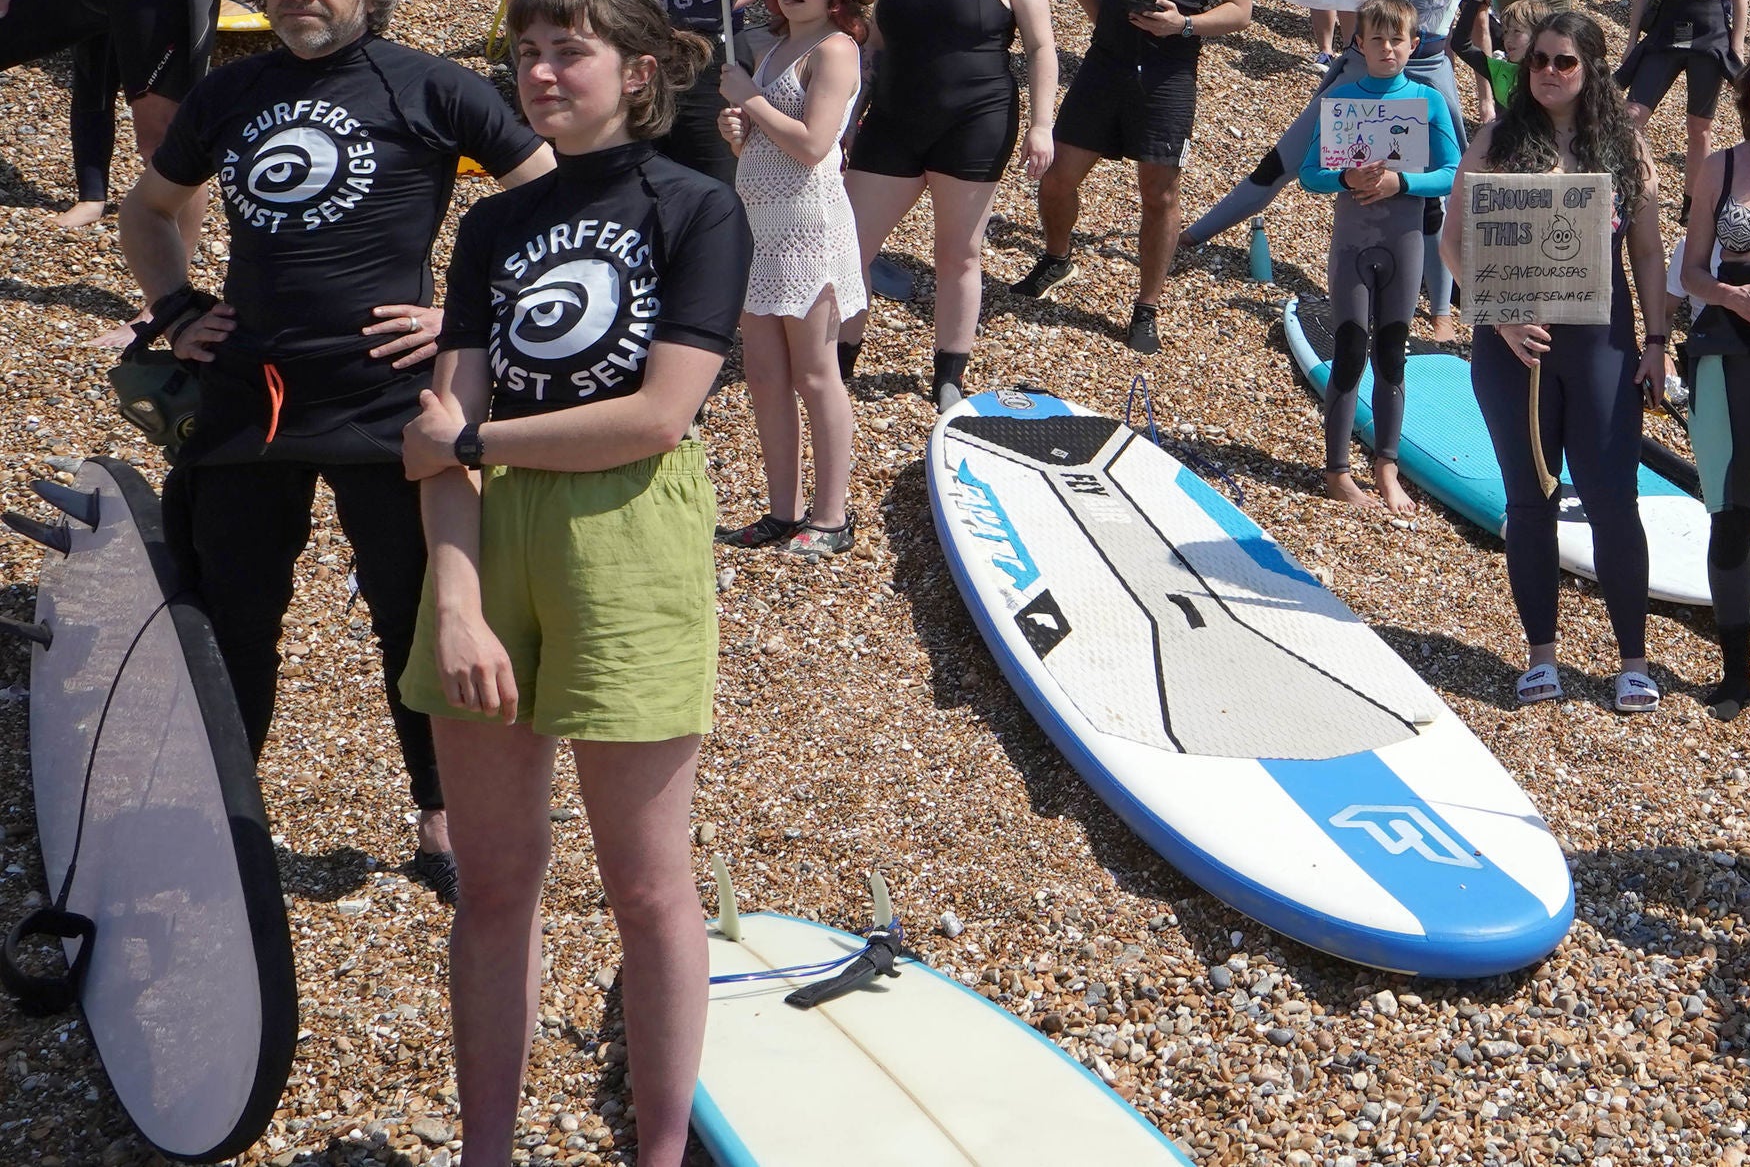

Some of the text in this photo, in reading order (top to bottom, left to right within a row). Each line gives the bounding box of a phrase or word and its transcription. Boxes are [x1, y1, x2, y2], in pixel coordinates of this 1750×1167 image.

[242, 99, 361, 143] SURFERS
[1333, 103, 1386, 118] SAVE
[1335, 133, 1375, 146] SEAS
[220, 148, 288, 234] AGAINST
[302, 141, 377, 231] SEWAGE
[1472, 183, 1596, 214] ENOUGH OF
[504, 219, 650, 280] SURFERS
[1476, 221, 1533, 246] THIS
[570, 275, 662, 398] SEWAGE
[1060, 473, 1111, 498] FLY
